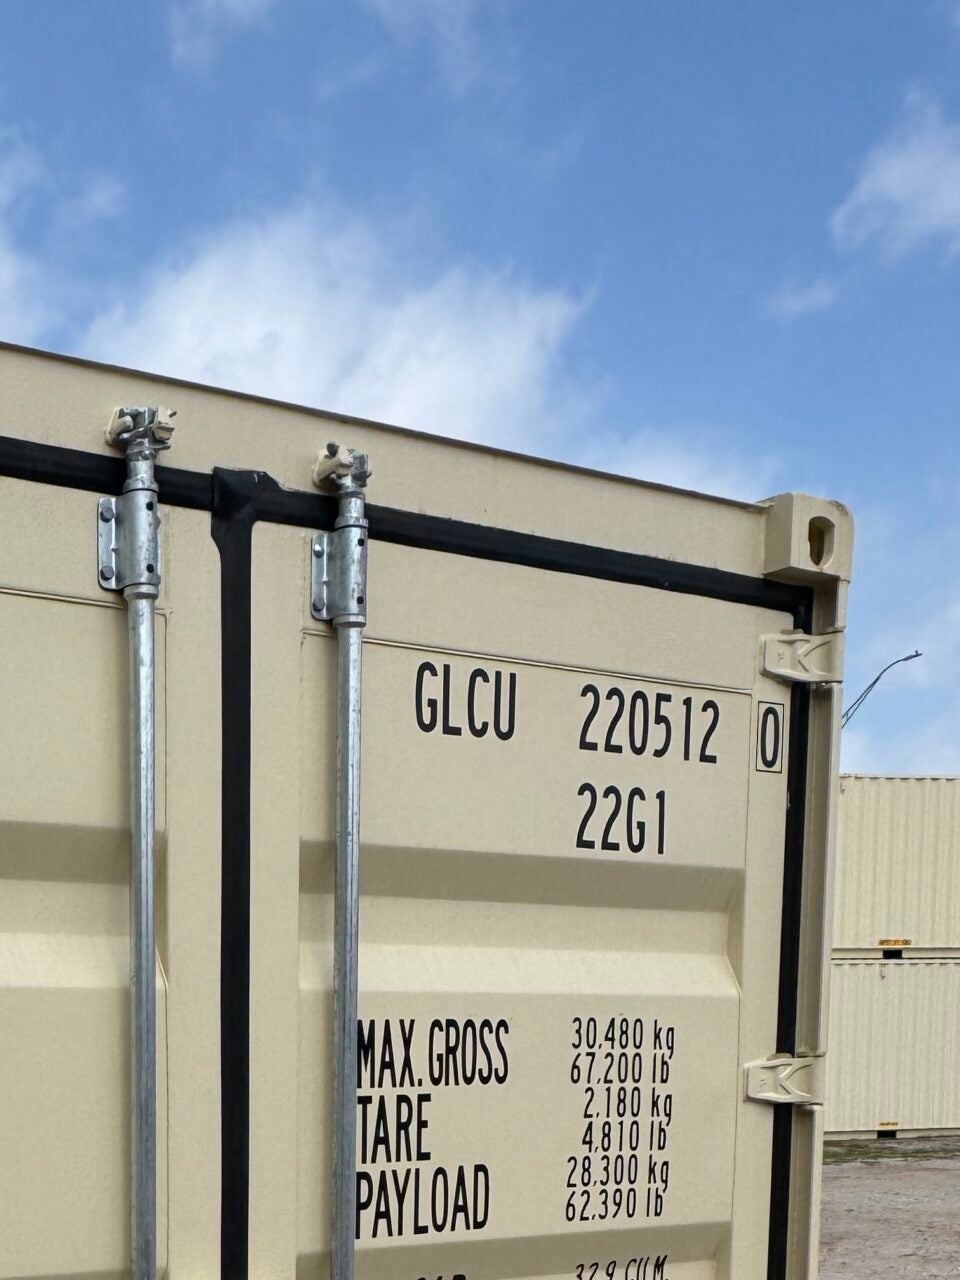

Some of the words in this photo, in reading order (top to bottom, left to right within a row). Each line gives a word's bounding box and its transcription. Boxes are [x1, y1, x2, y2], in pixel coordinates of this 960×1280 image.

[415, 661, 517, 741] GLCU
[578, 683, 720, 764] 220512
[575, 782, 666, 855] 22G1
[570, 1051, 642, 1084] 67,200
[652, 1052, 670, 1083] lb
[653, 1019, 675, 1060] kg
[357, 1093, 431, 1164] TARE
[651, 1086, 673, 1127] kg
[581, 1120, 640, 1153] 4,810
[649, 1120, 667, 1151] lb
[355, 1164, 490, 1239] PAYLOAD
[566, 1154, 638, 1188] 28,300
[647, 1154, 669, 1194] kg
[565, 1187, 637, 1222] 62,390
[646, 1187, 663, 1217] lb
